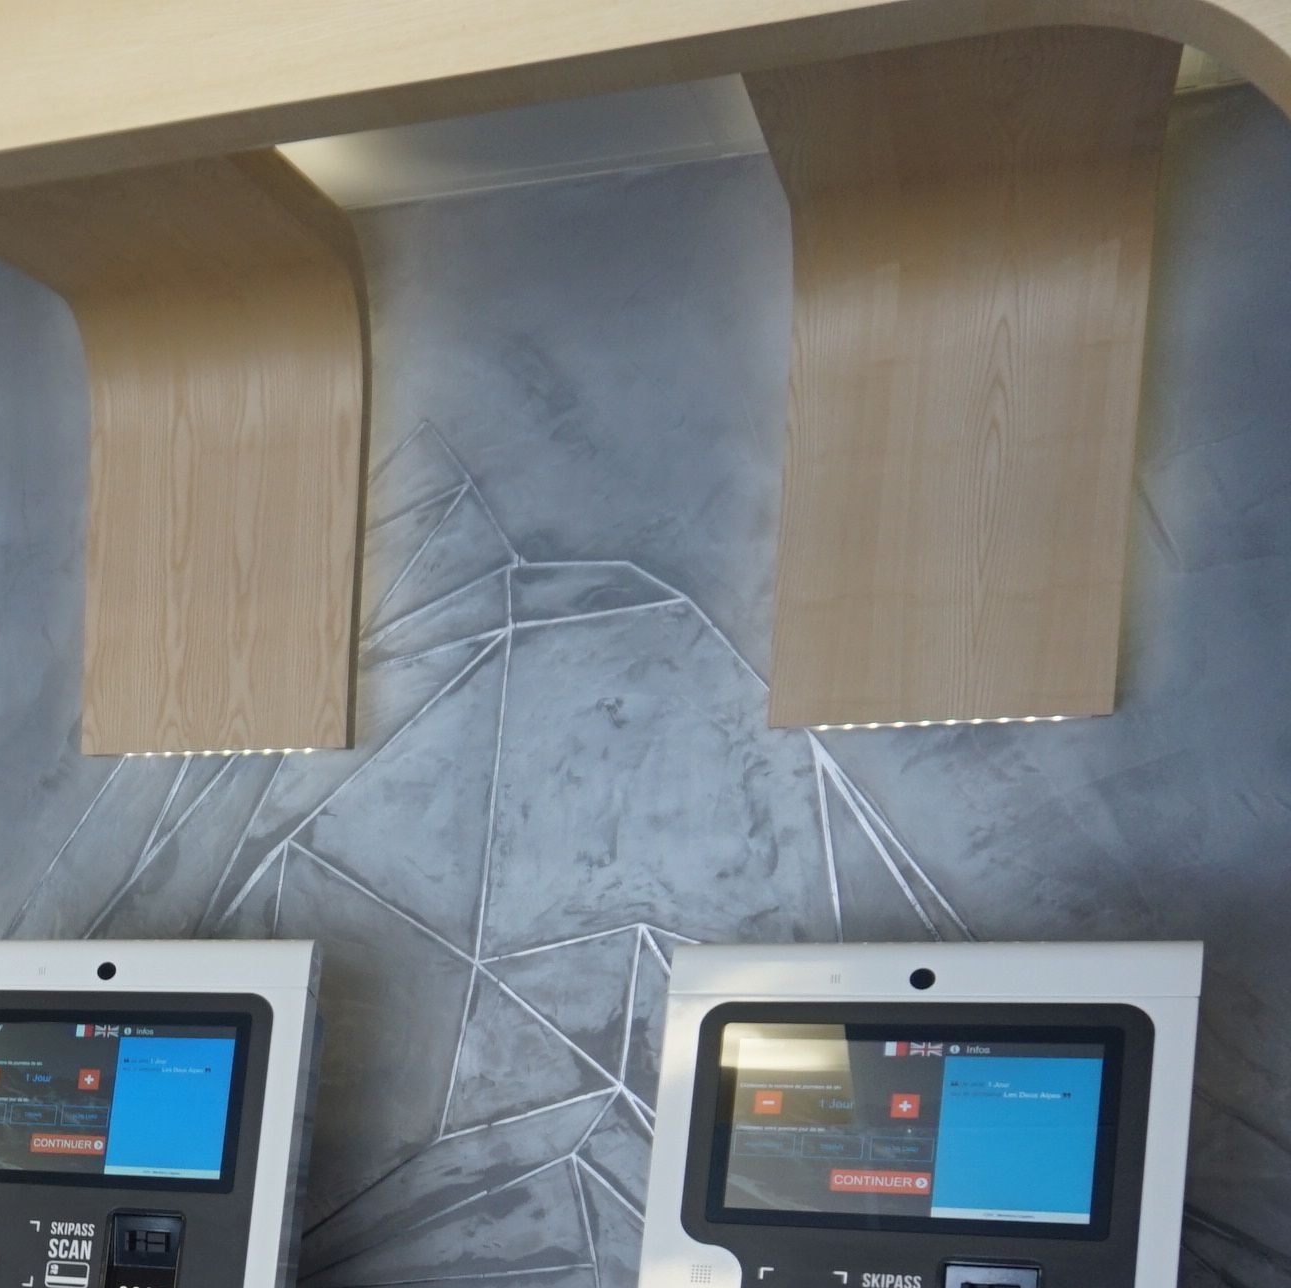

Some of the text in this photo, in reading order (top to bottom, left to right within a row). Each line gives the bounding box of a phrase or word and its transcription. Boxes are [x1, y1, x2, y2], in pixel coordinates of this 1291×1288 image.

[966, 1043, 991, 1055] Infos
[32, 1073, 52, 1083] Jour
[829, 1098, 856, 1110] Jour
[33, 1138, 92, 1150] CONTINUER
[833, 1173, 913, 1189] CONTINUER
[50, 1221, 95, 1237] SKIPASS
[48, 1238, 92, 1260] SCAN
